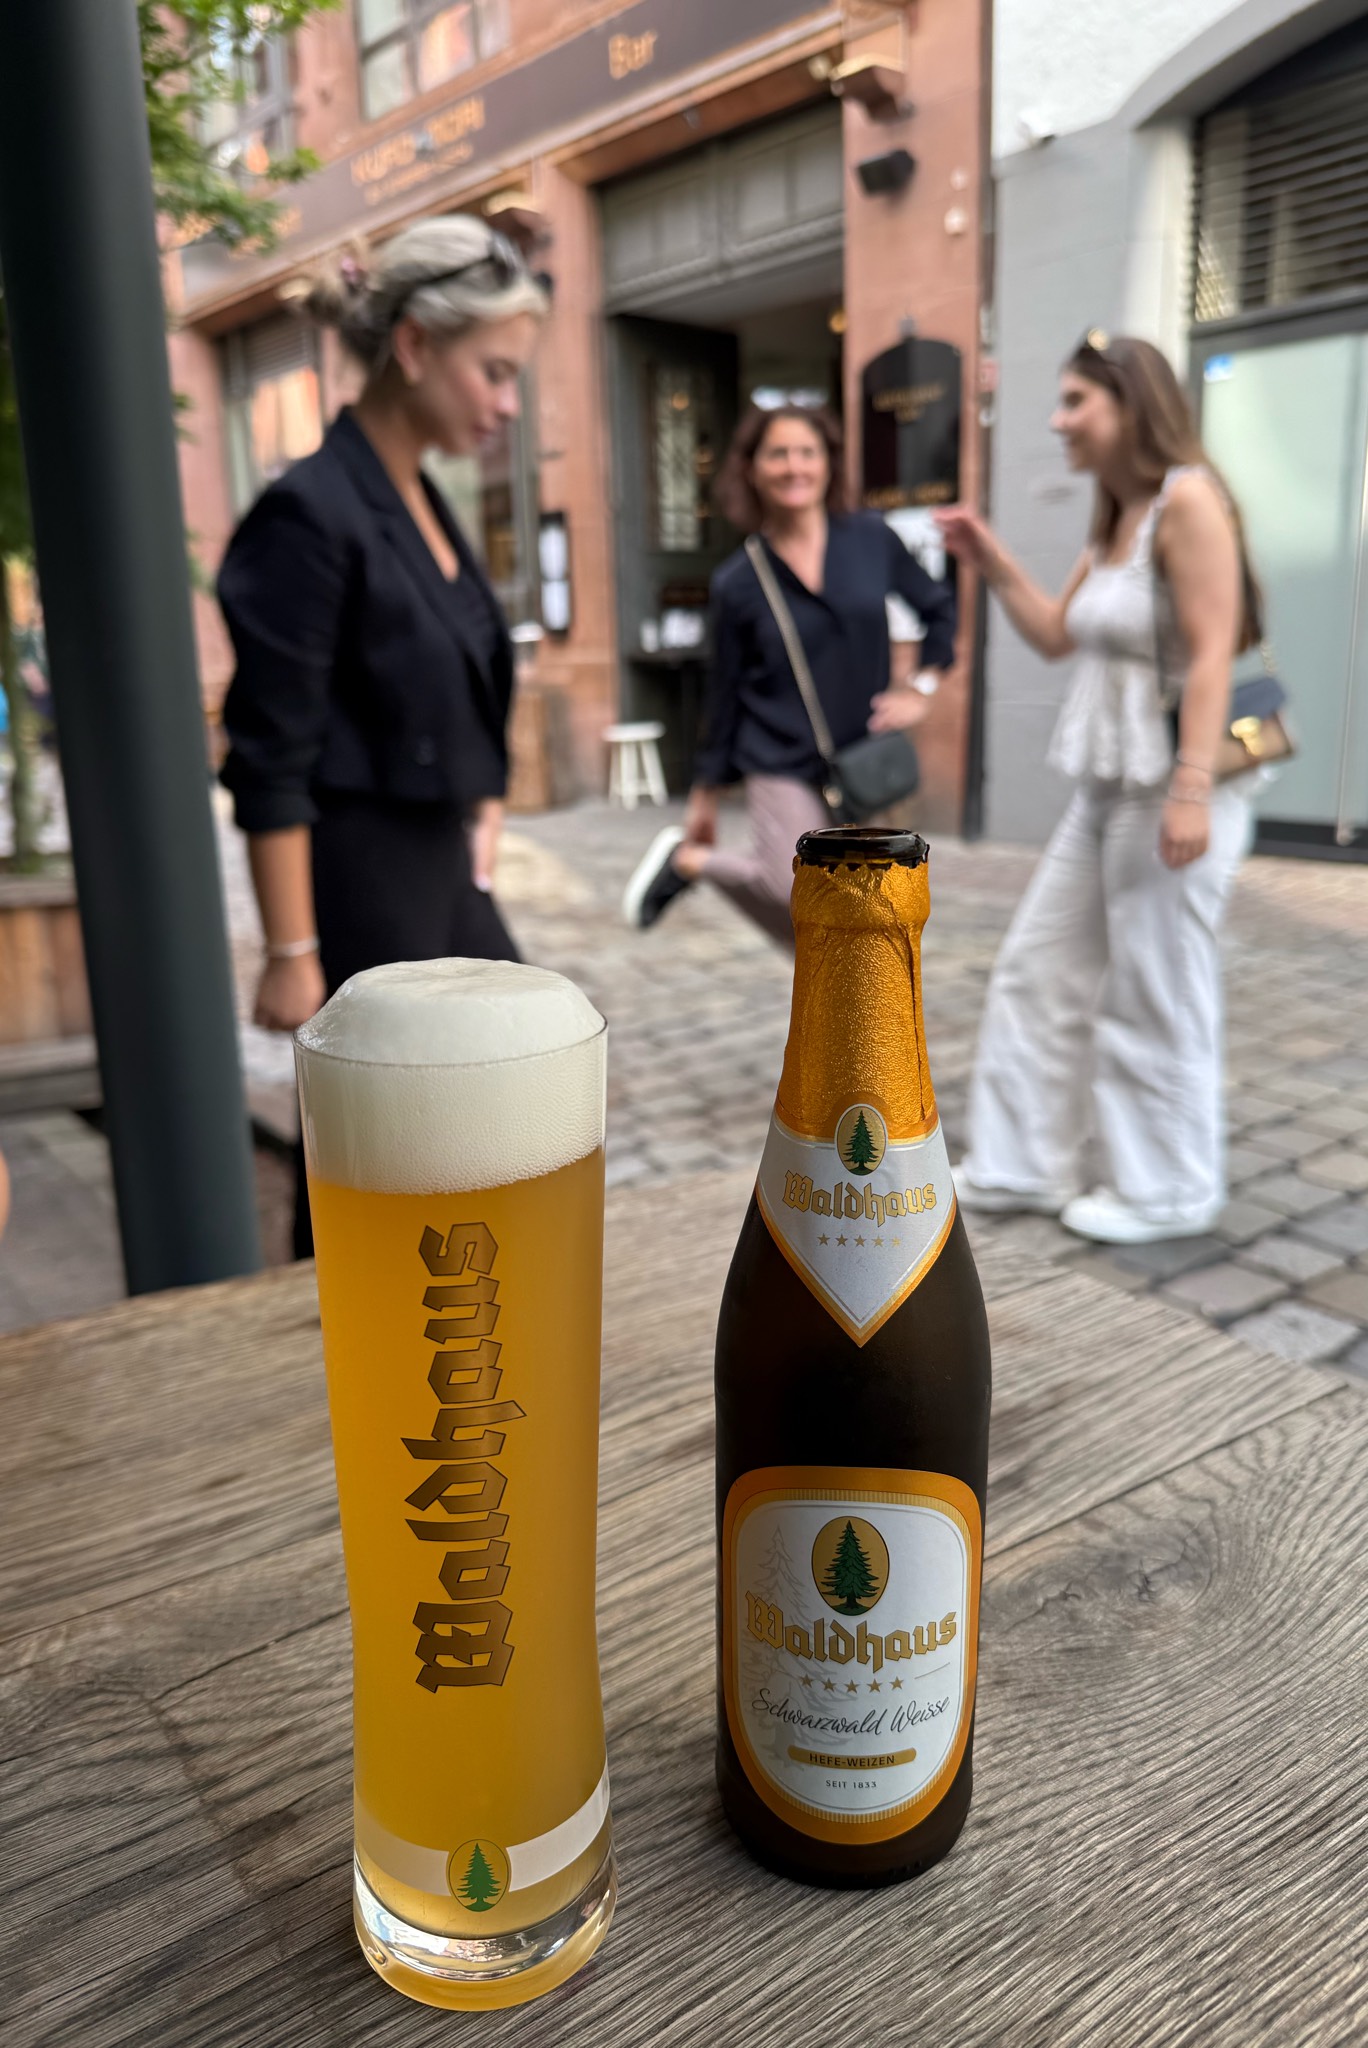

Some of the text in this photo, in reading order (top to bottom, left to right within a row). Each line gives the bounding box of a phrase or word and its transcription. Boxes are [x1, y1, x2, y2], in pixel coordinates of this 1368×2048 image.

[609, 32, 657, 79] Bar
[782, 1170, 937, 1227] Waldhaus
[401, 1222, 527, 1693] Waldhaus
[746, 1590, 956, 1673] Waldhaus
[752, 1688, 950, 1735] Schwarzwald Weisse
[809, 1753, 895, 1767] HEFE-WEIZEN
[825, 1779, 877, 1789] SEIT 1833
